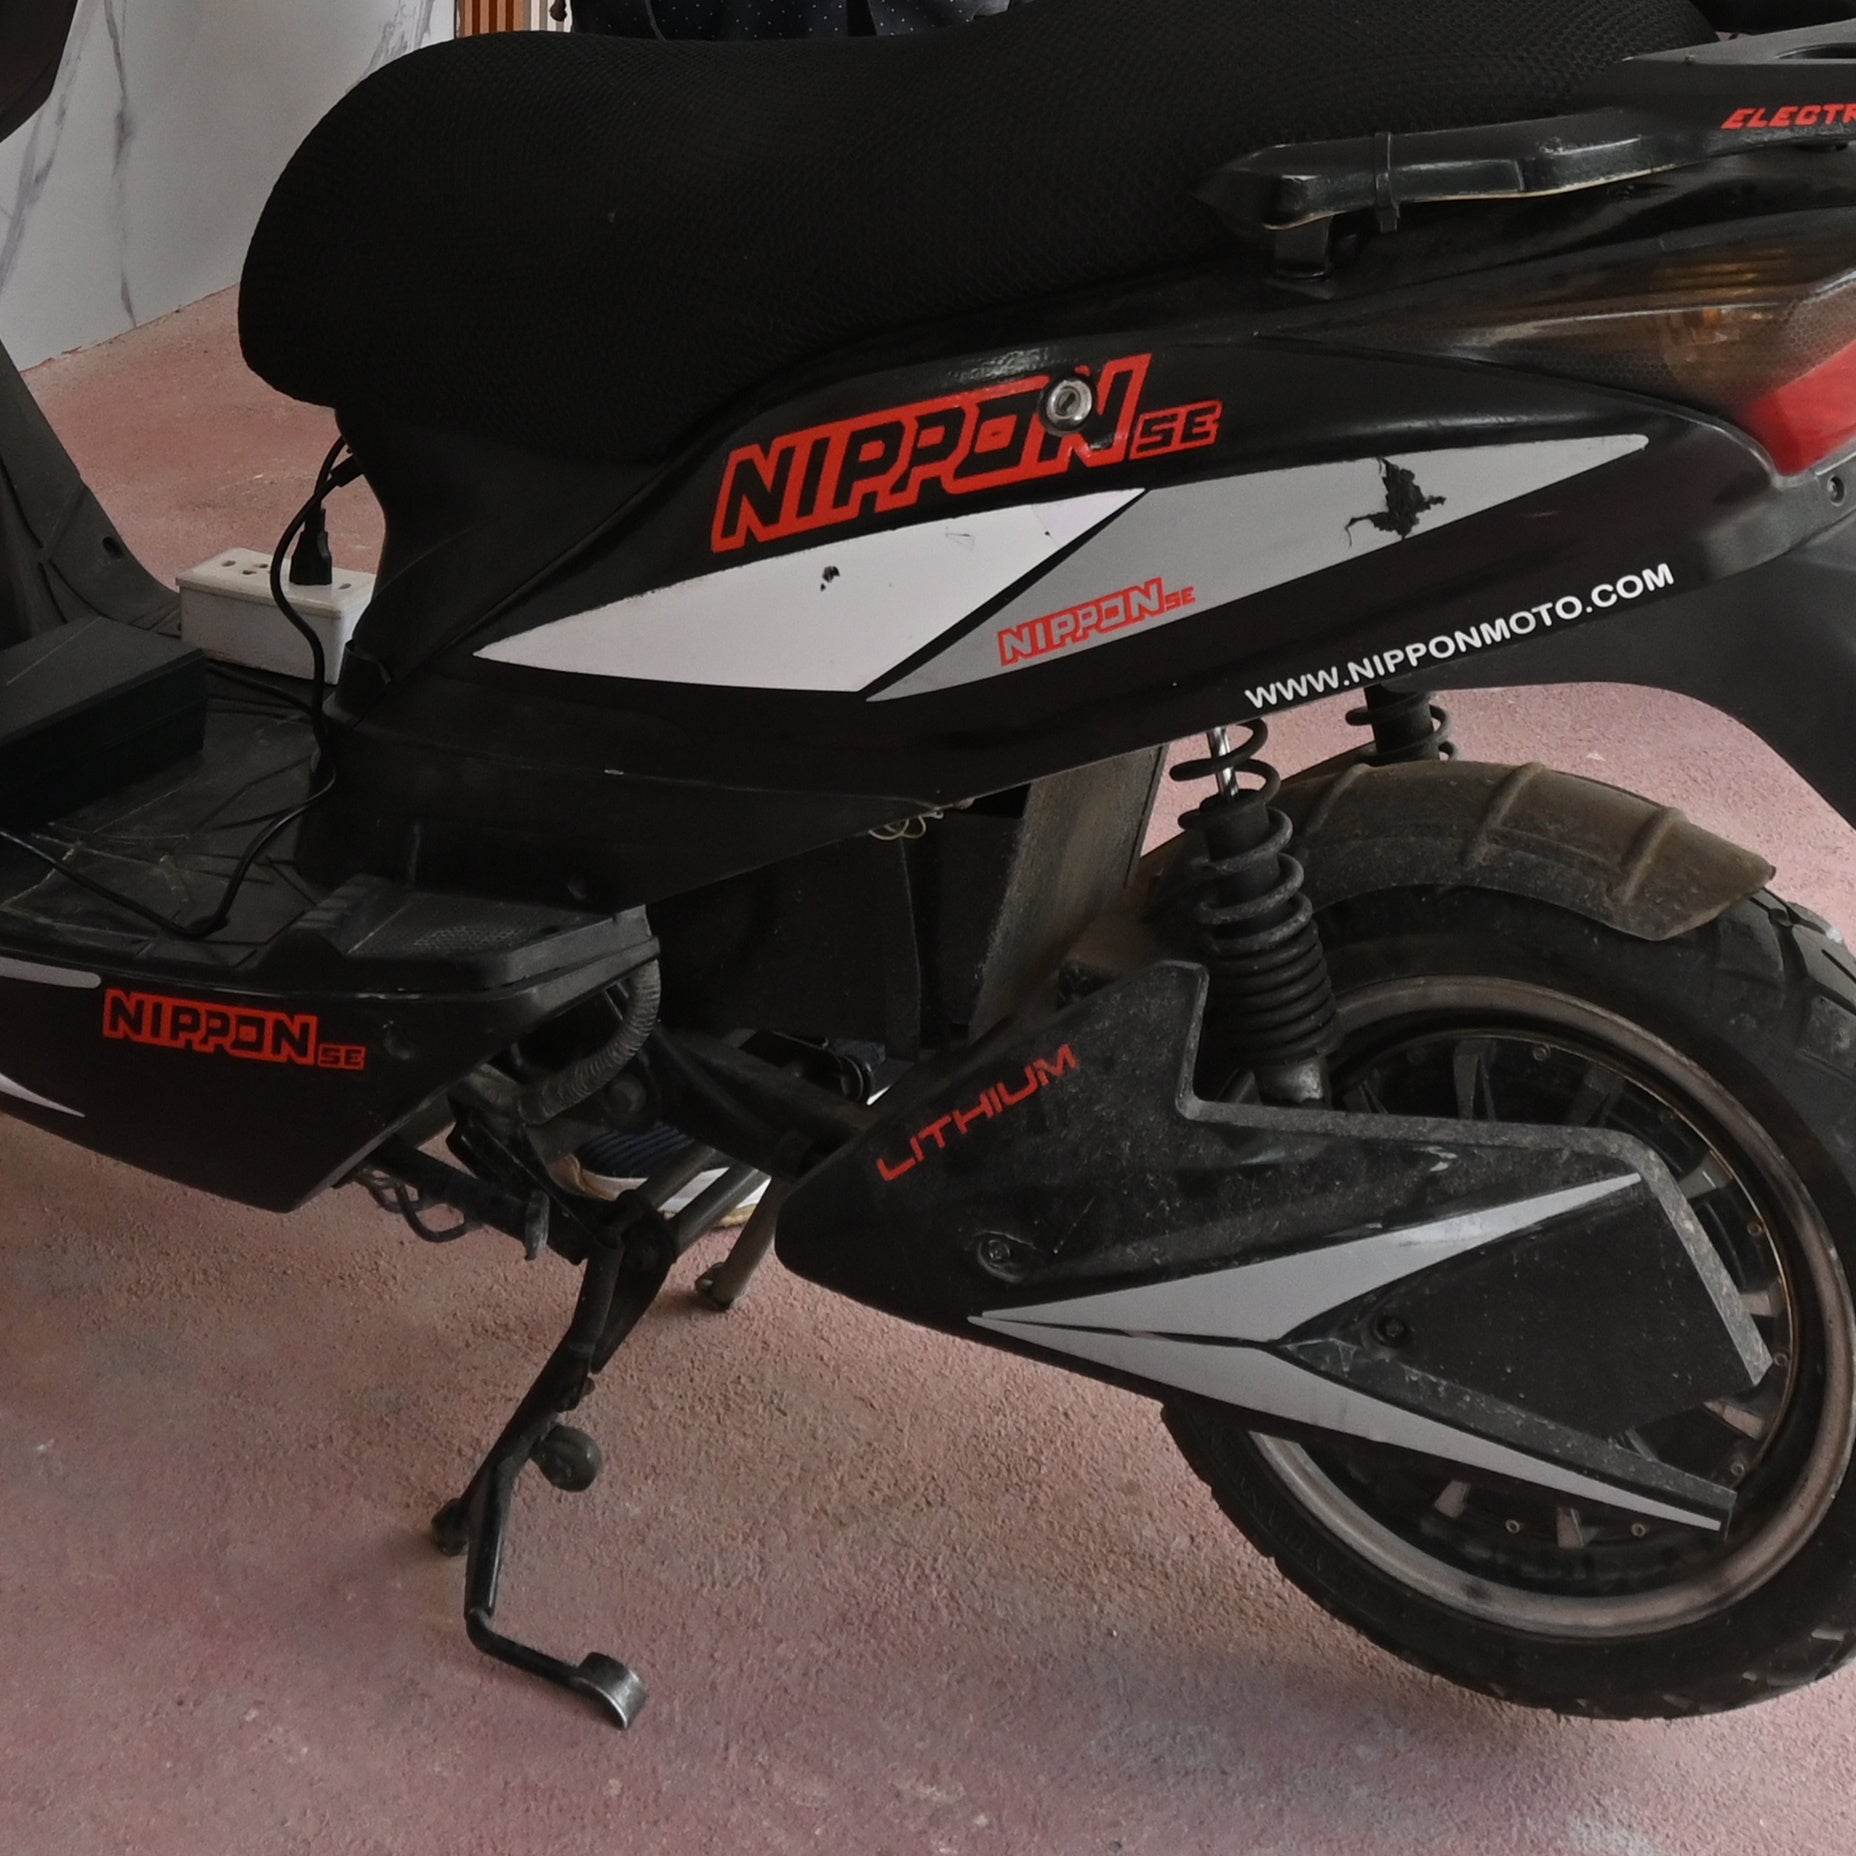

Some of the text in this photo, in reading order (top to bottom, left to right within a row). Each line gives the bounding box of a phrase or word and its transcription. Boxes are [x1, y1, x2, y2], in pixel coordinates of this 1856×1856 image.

[998, 577, 1166, 666] NIPPON
[1245, 562, 1674, 709] WWW.NIPPONMOTO.COM
[102, 988, 318, 1066] NIPPON
[876, 1043, 1080, 1181] LITHIUM
